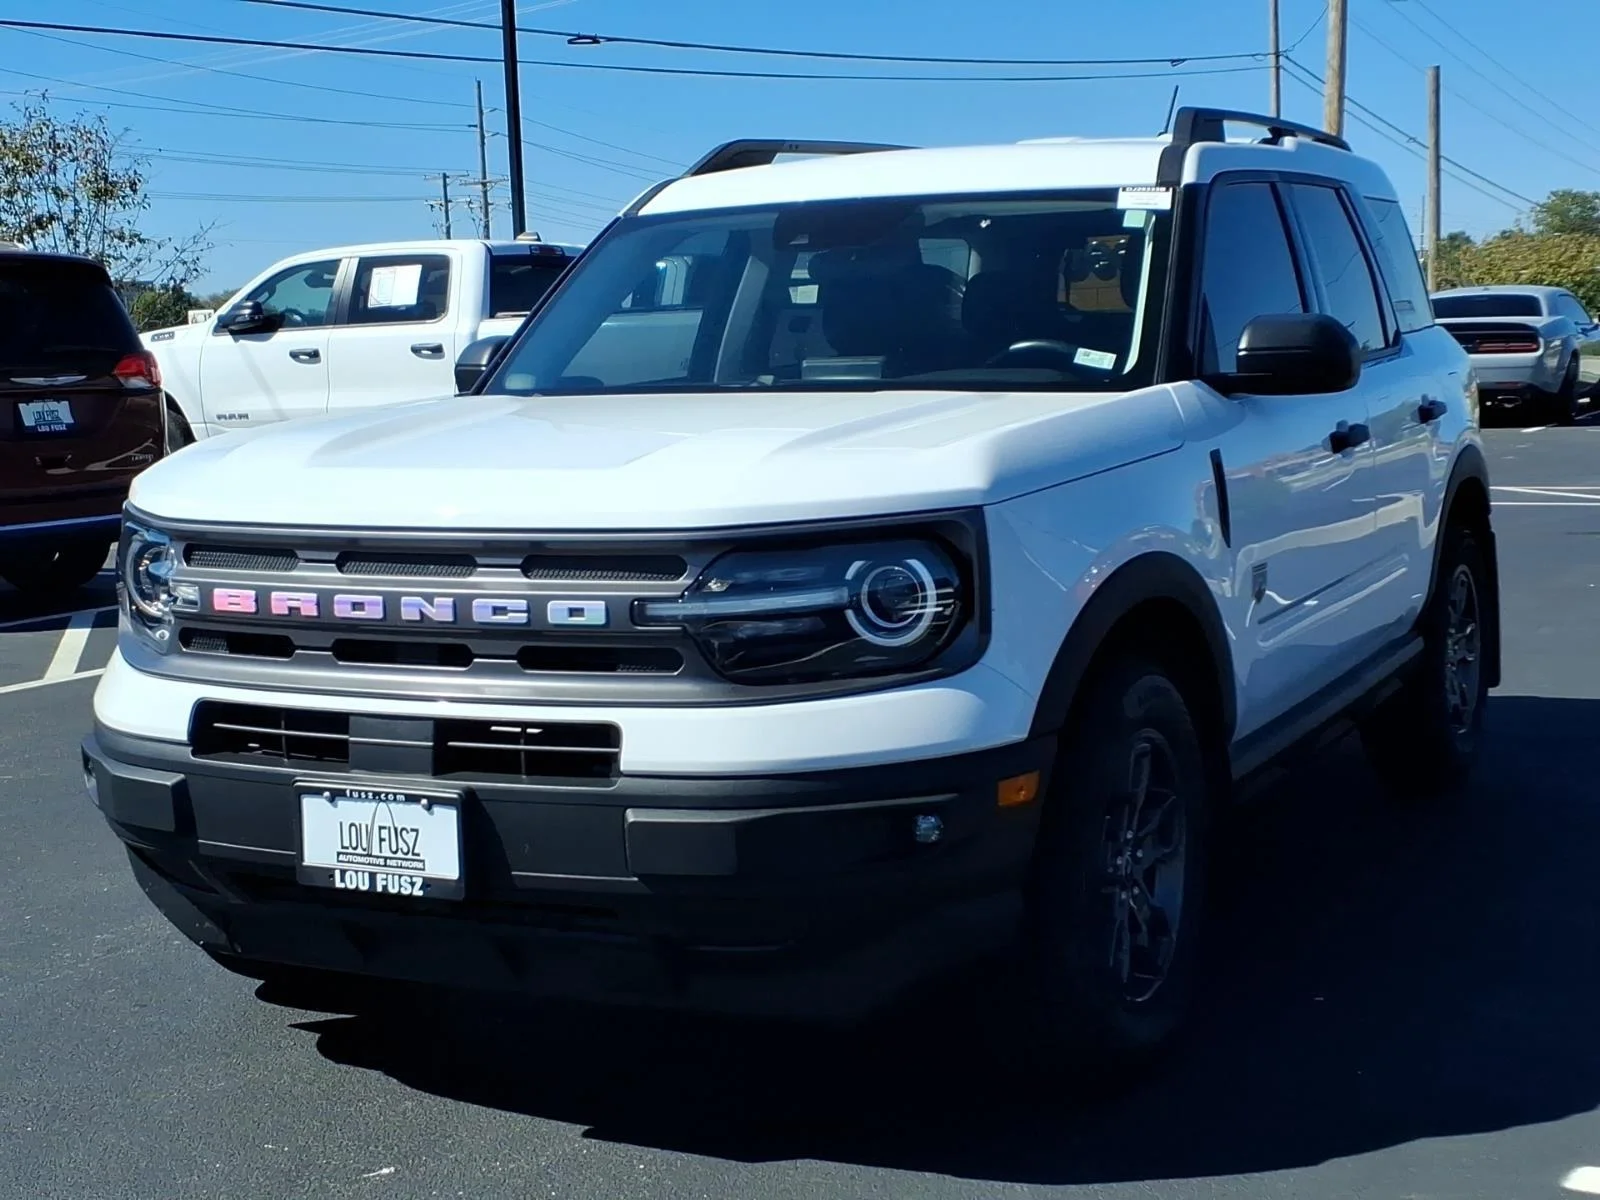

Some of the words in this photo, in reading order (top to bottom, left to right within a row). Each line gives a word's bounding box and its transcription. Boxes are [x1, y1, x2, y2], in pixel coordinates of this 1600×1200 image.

[216, 413, 249, 421] RAM
[51, 424, 67, 432] FUSZ
[212, 588, 608, 626] BRONCO
[346, 789, 405, 801] fusz.com
[339, 821, 369, 851] LOU
[378, 825, 420, 857] FUSZ
[338, 854, 385, 866] AUTOMOTIVE
[386, 858, 425, 869] NETWORK
[334, 869, 370, 890] LOU
[376, 873, 424, 896] FUSZ
